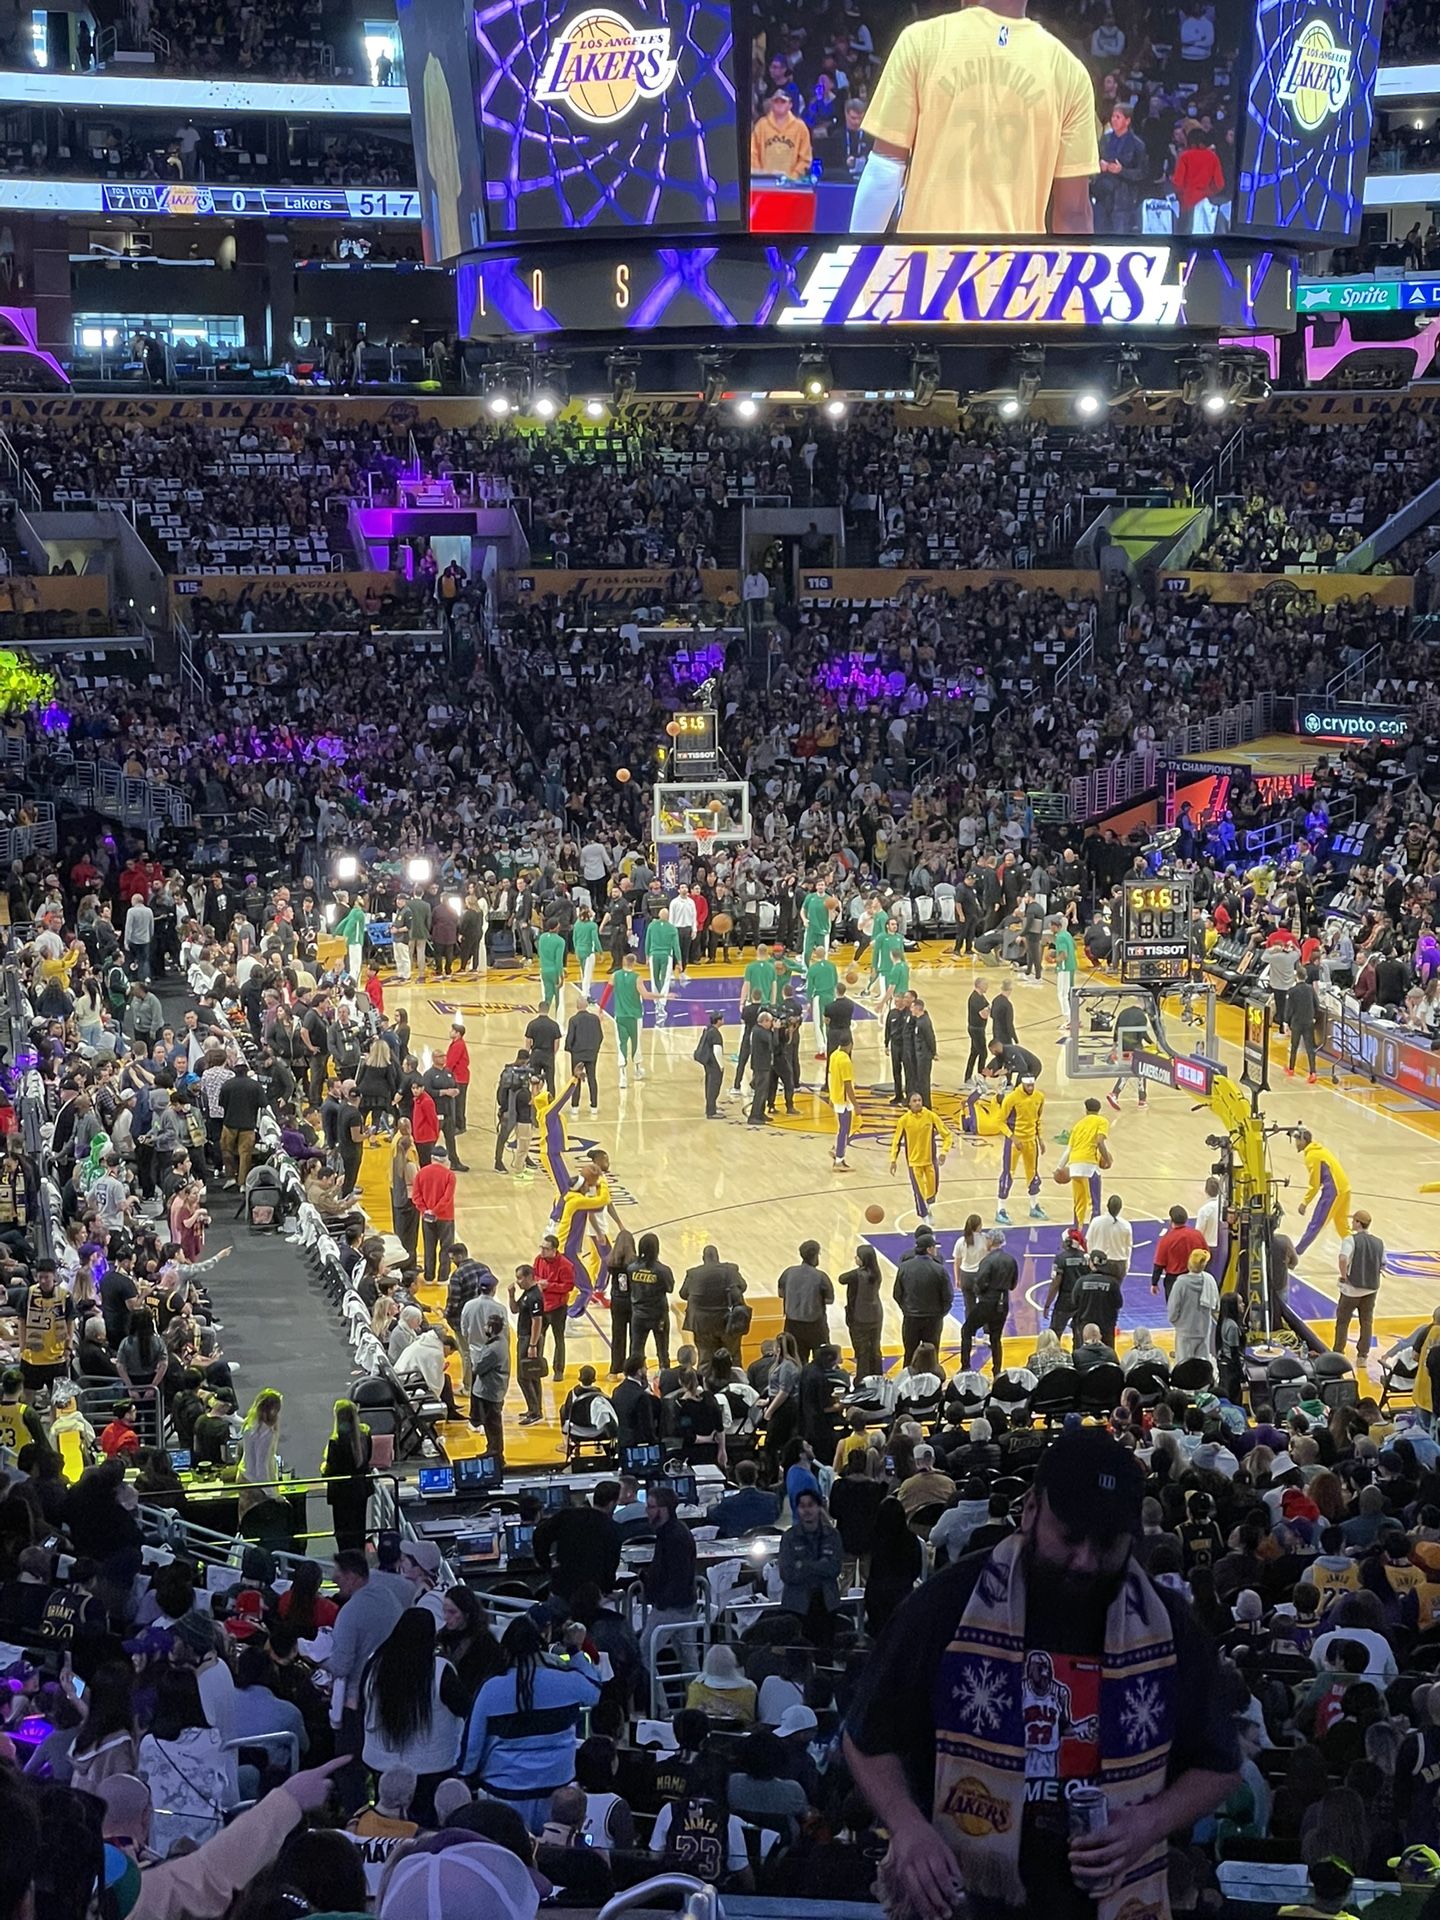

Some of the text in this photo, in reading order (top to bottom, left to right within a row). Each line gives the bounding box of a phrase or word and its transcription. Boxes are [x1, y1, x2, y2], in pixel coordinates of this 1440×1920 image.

[580, 34, 665, 49] LOS ANGELES
[1306, 47, 1347, 63] LOS ANGELES
[543, 41, 671, 94] LAKERS
[1283, 45, 1346, 105] LAKERS
[115, 196, 124, 208] 7
[140, 196, 149, 208] 0
[232, 191, 246, 211] 0
[284, 196, 332, 210] Lakers
[359, 193, 415, 216] 51.7
[822, 245, 1156, 325] LAKERS
[1340, 287, 1389, 308] Sprite
[169, 400, 320, 419] LAKERS
[178, 582, 198, 594] 115
[807, 577, 829, 589] 116
[1167, 579, 1186, 591] 117
[687, 751, 715, 759] TISSOT
[1168, 761, 1232, 775] 17x CHAMPIONS
[1132, 888, 1172, 908] 51.6
[1144, 945, 1187, 955] TISSOT
[47, 1604, 76, 1621] BRYANT
[942, 1786, 1011, 1833] LAKERS
[683, 1817, 719, 1834] JAMES
